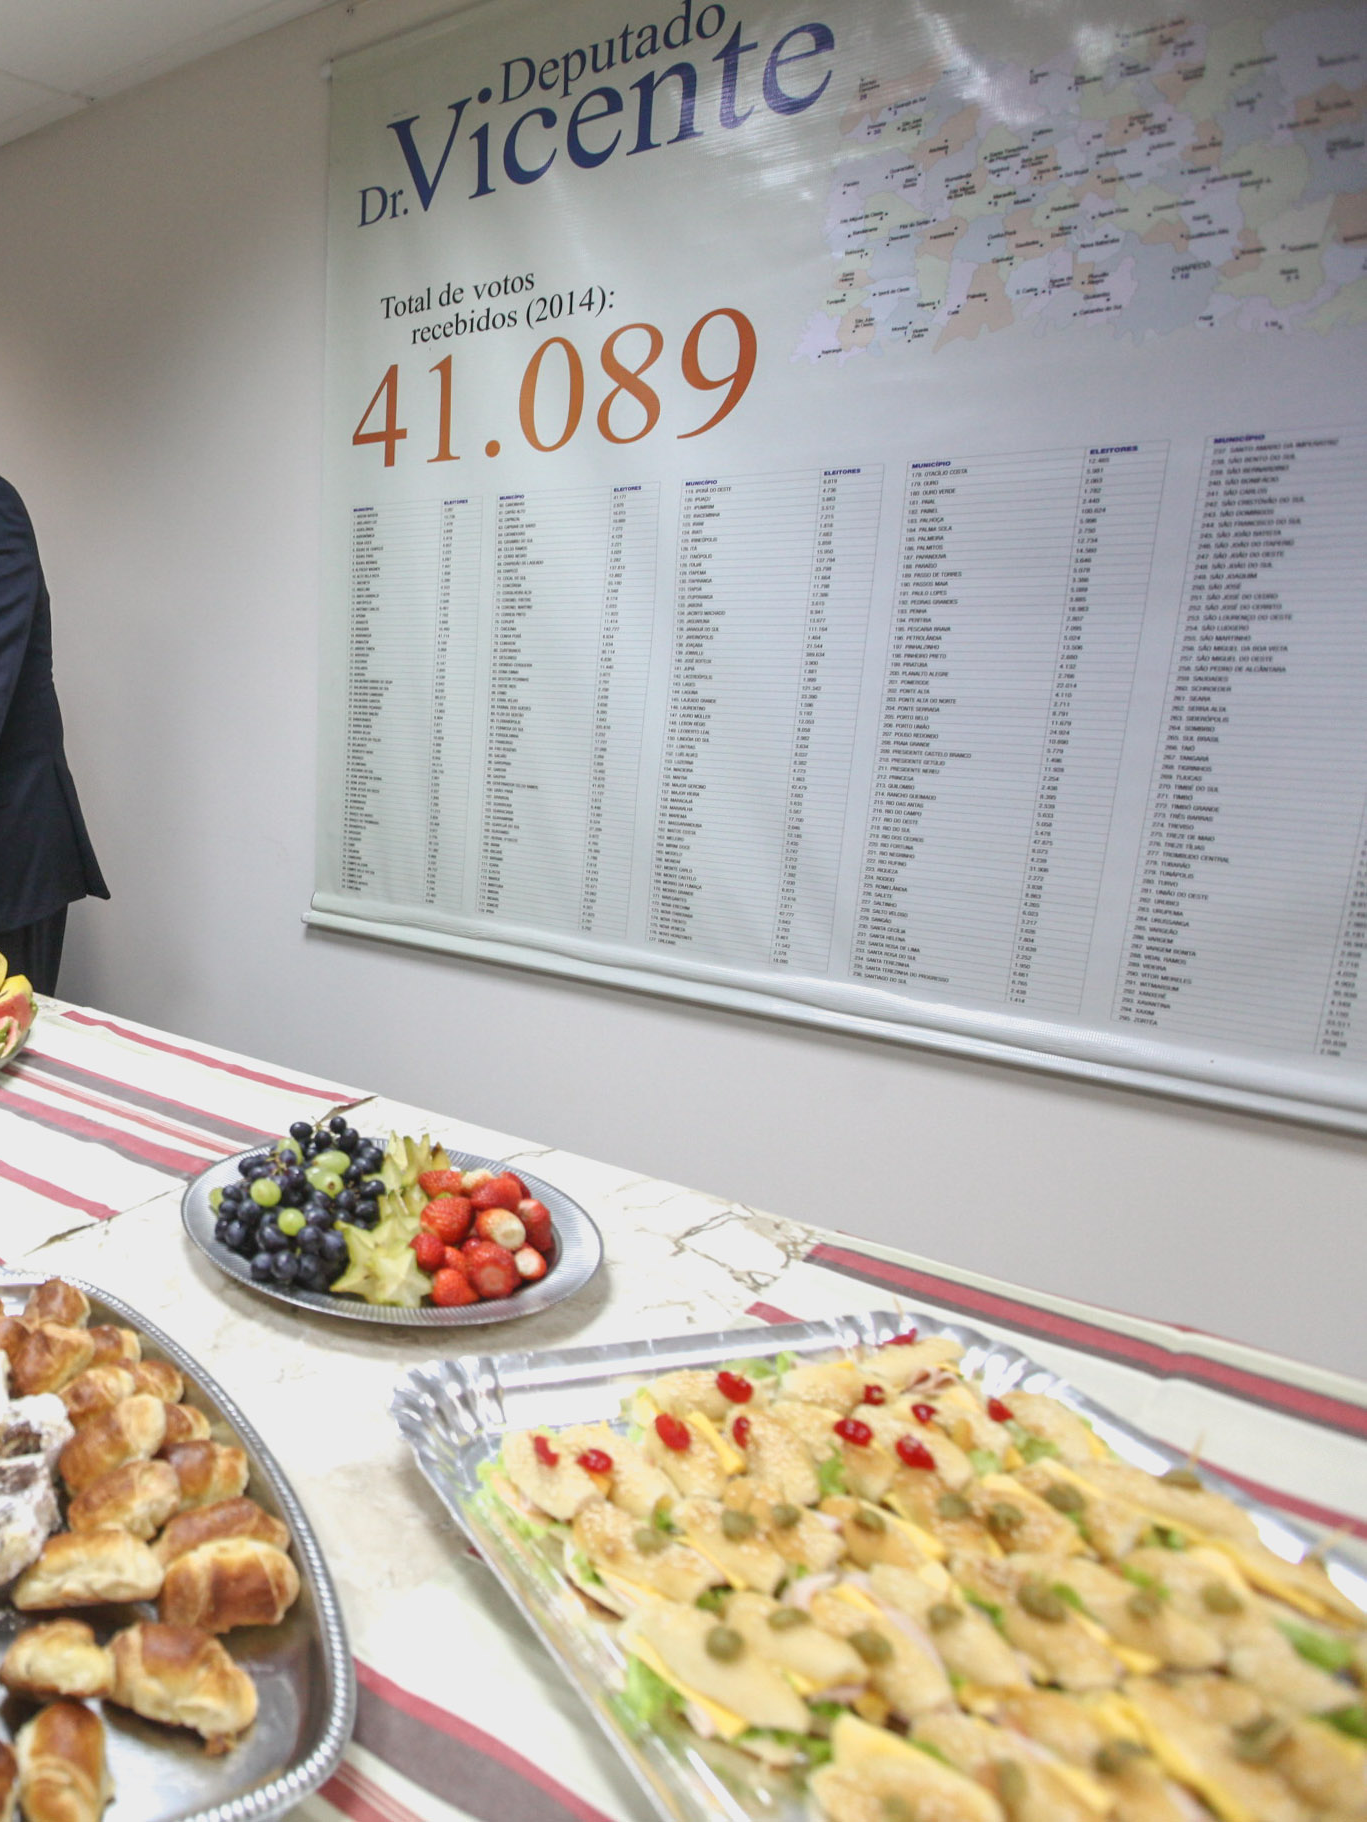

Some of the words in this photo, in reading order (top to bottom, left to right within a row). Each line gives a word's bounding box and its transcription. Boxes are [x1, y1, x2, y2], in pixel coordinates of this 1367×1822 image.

[498, 0, 726, 104] Deputado
[357, 186, 409, 228] Dr.
[386, 22, 835, 212] Vicente
[380, 287, 432, 319] Total
[438, 282, 464, 308] de
[473, 272, 535, 300] votos
[411, 308, 518, 344] recebidos
[526, 285, 615, 329] (2014):
[352, 307, 757, 468] 41.089
[823, 467, 861, 476] ELEITORES
[911, 460, 951, 468] MUNICÍPIO
[1089, 445, 1138, 455] ELEITORES
[612, 484, 642, 492] ELEITORES
